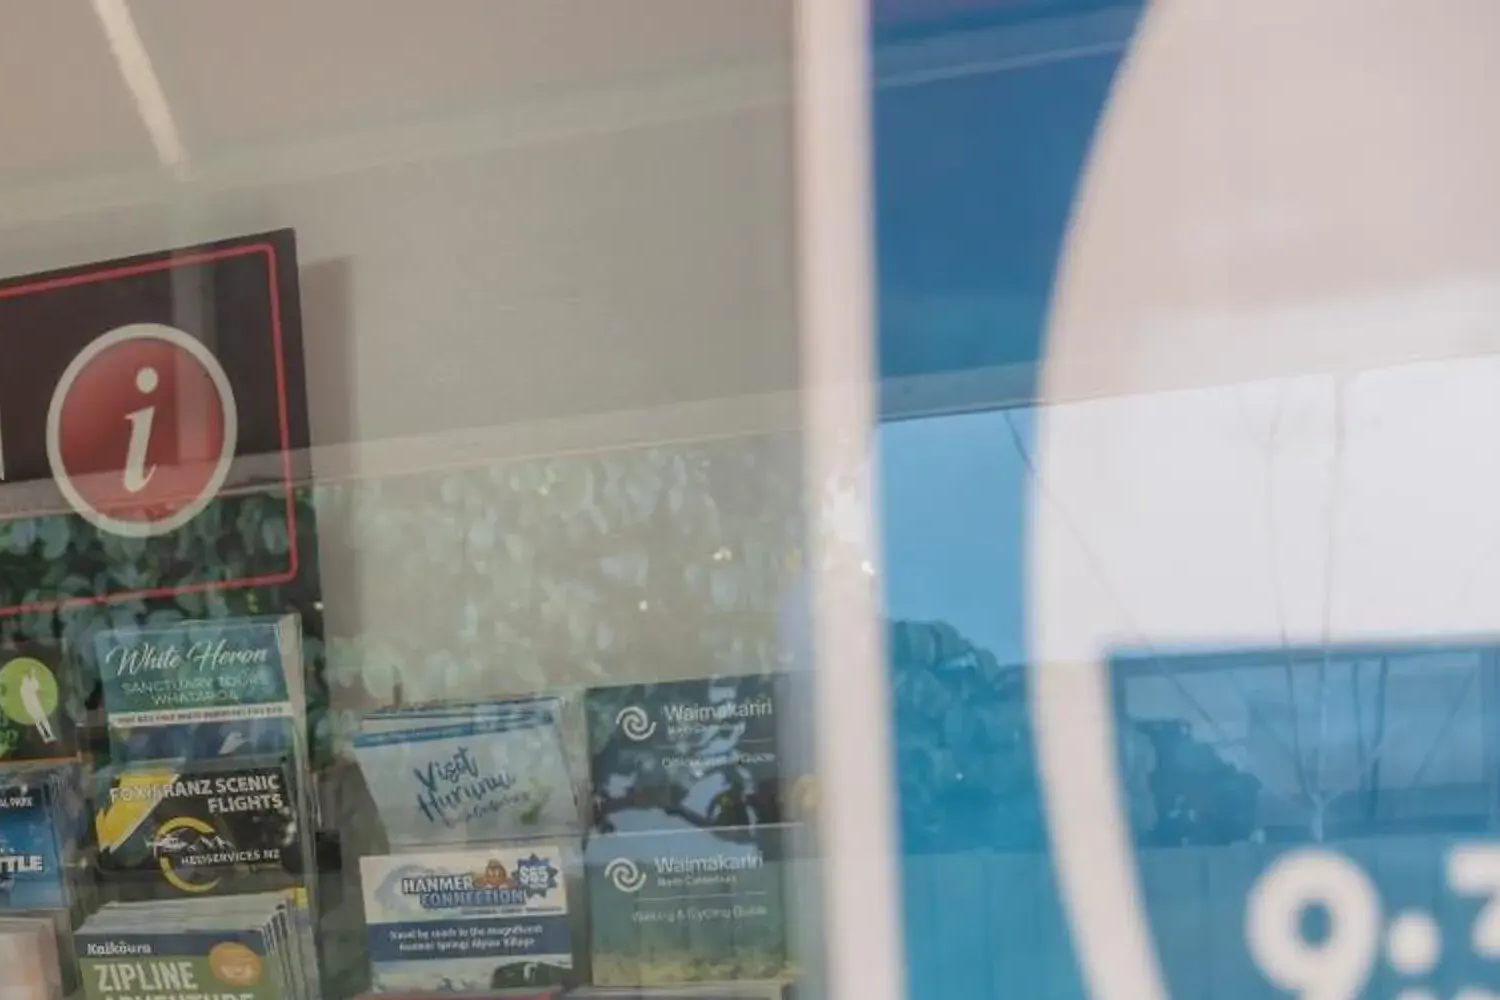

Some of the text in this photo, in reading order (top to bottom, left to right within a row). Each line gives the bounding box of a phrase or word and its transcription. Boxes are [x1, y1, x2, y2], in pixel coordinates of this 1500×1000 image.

[120, 366, 160, 494] i
[106, 639, 268, 676] White Heron
[216, 775, 280, 794] SCENIC
[208, 794, 282, 813] FLIGHTS
[403, 875, 475, 894] HANMER
[420, 890, 526, 908] CONNECTION
[94, 961, 198, 992] ZIPLINE
